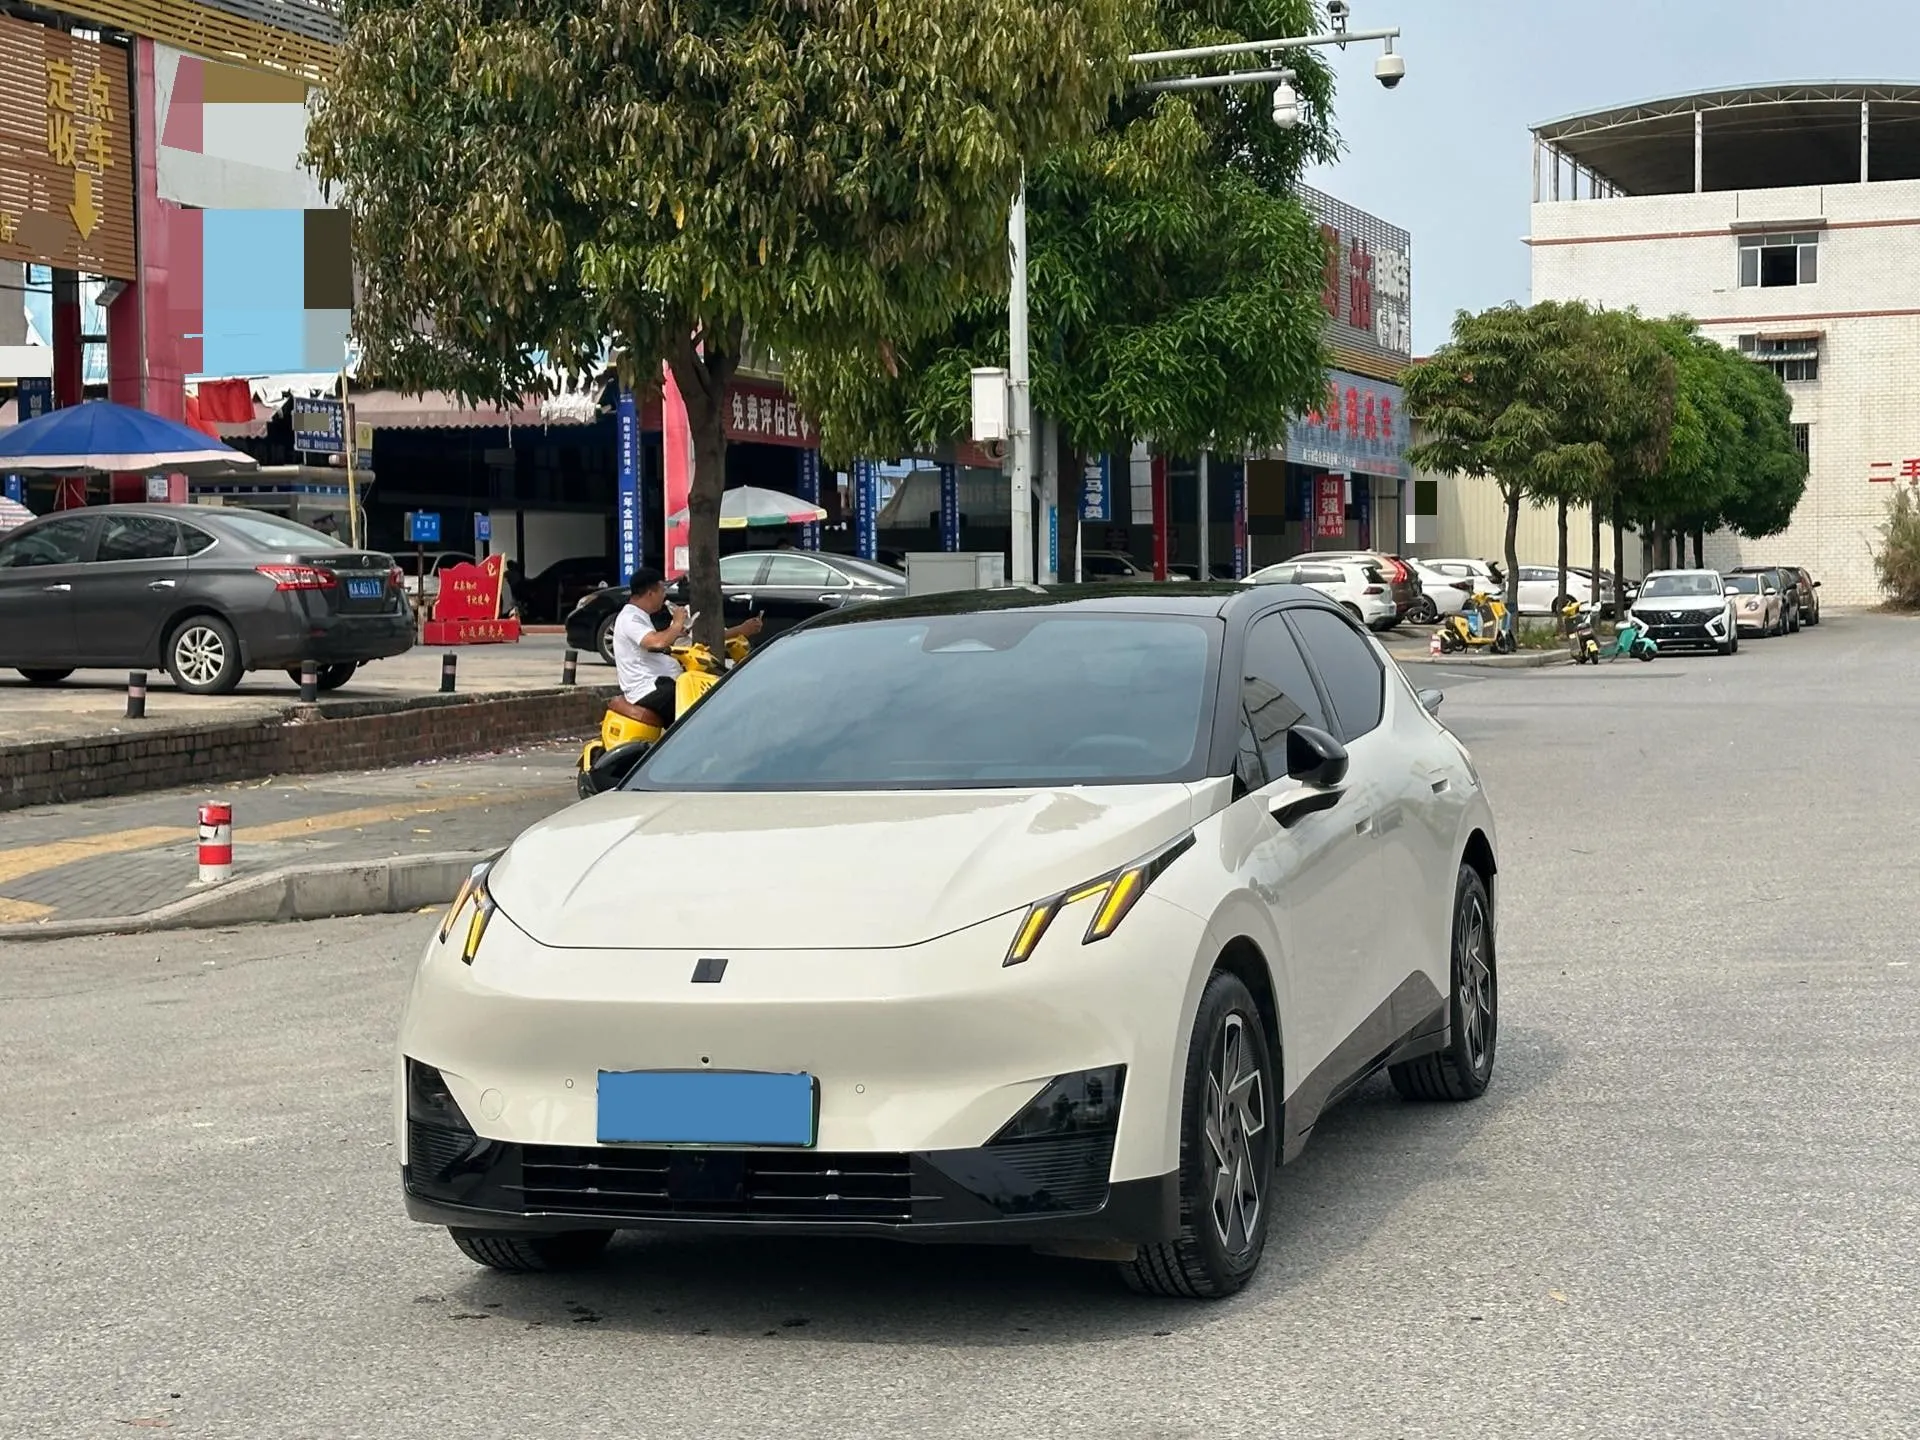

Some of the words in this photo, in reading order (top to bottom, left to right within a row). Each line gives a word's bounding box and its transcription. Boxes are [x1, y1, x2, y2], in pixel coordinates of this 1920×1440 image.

[46, 57, 114, 121] 定点
[48, 112, 114, 174] 收车
[732, 391, 798, 437] 免费评估区
